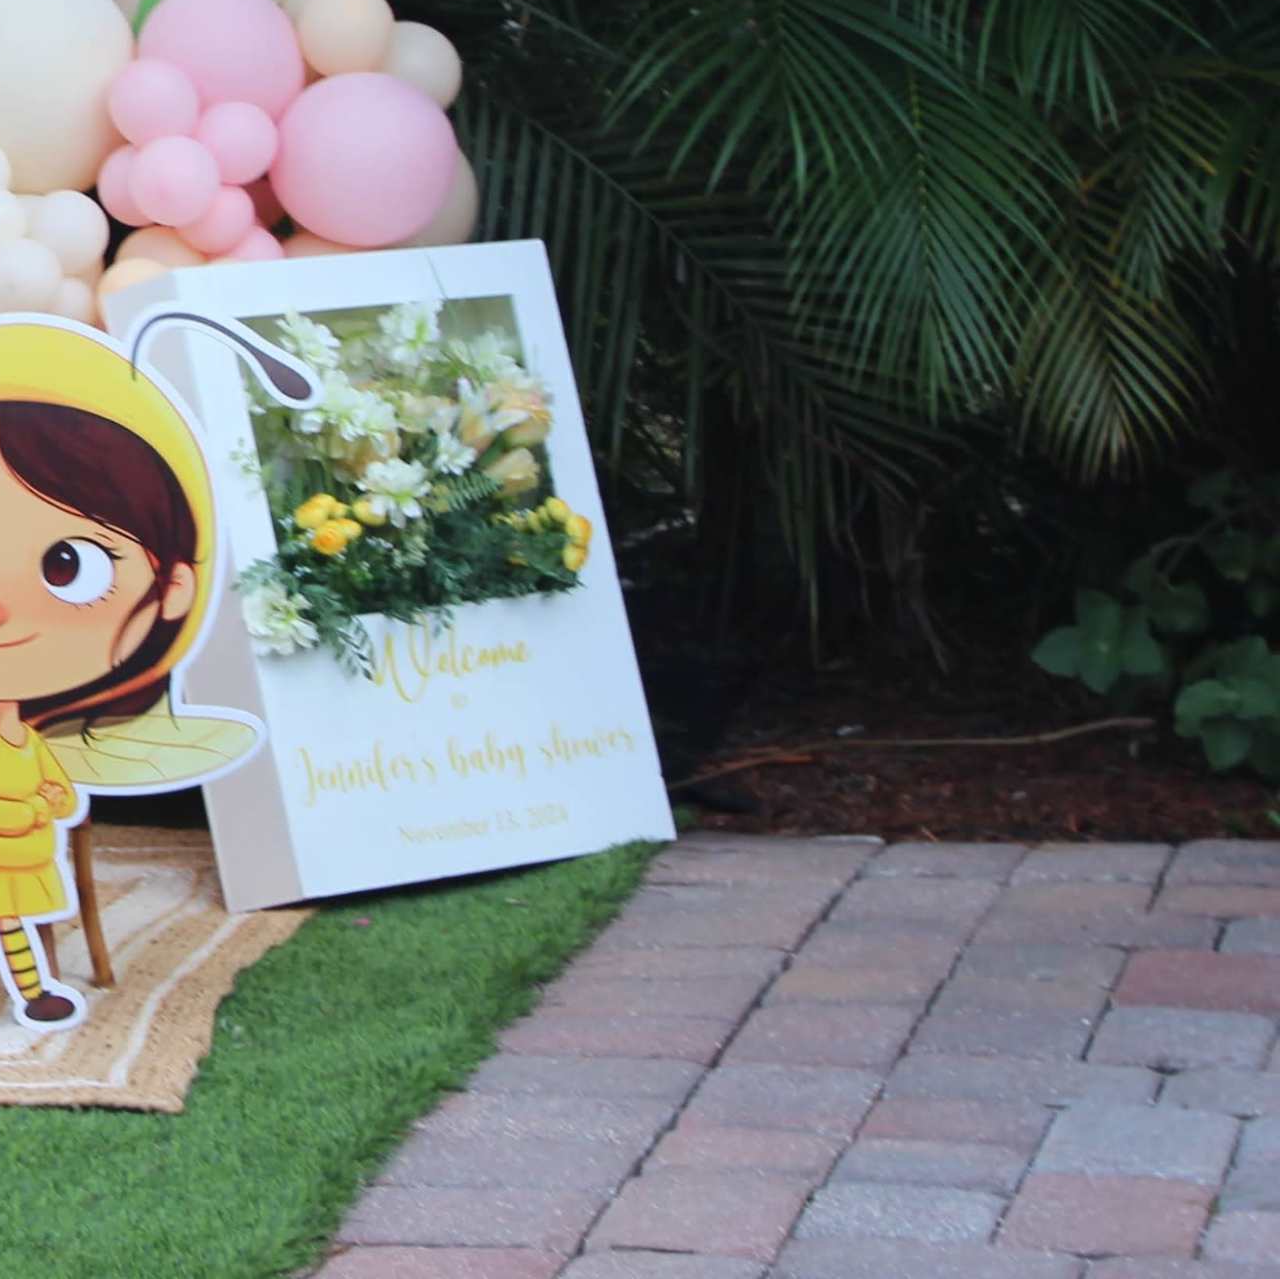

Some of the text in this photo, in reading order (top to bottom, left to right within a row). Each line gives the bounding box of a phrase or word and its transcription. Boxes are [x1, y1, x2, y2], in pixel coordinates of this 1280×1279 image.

[374, 613, 529, 703] Welcome
[448, 730, 528, 781] baby
[539, 722, 635, 767] shower
